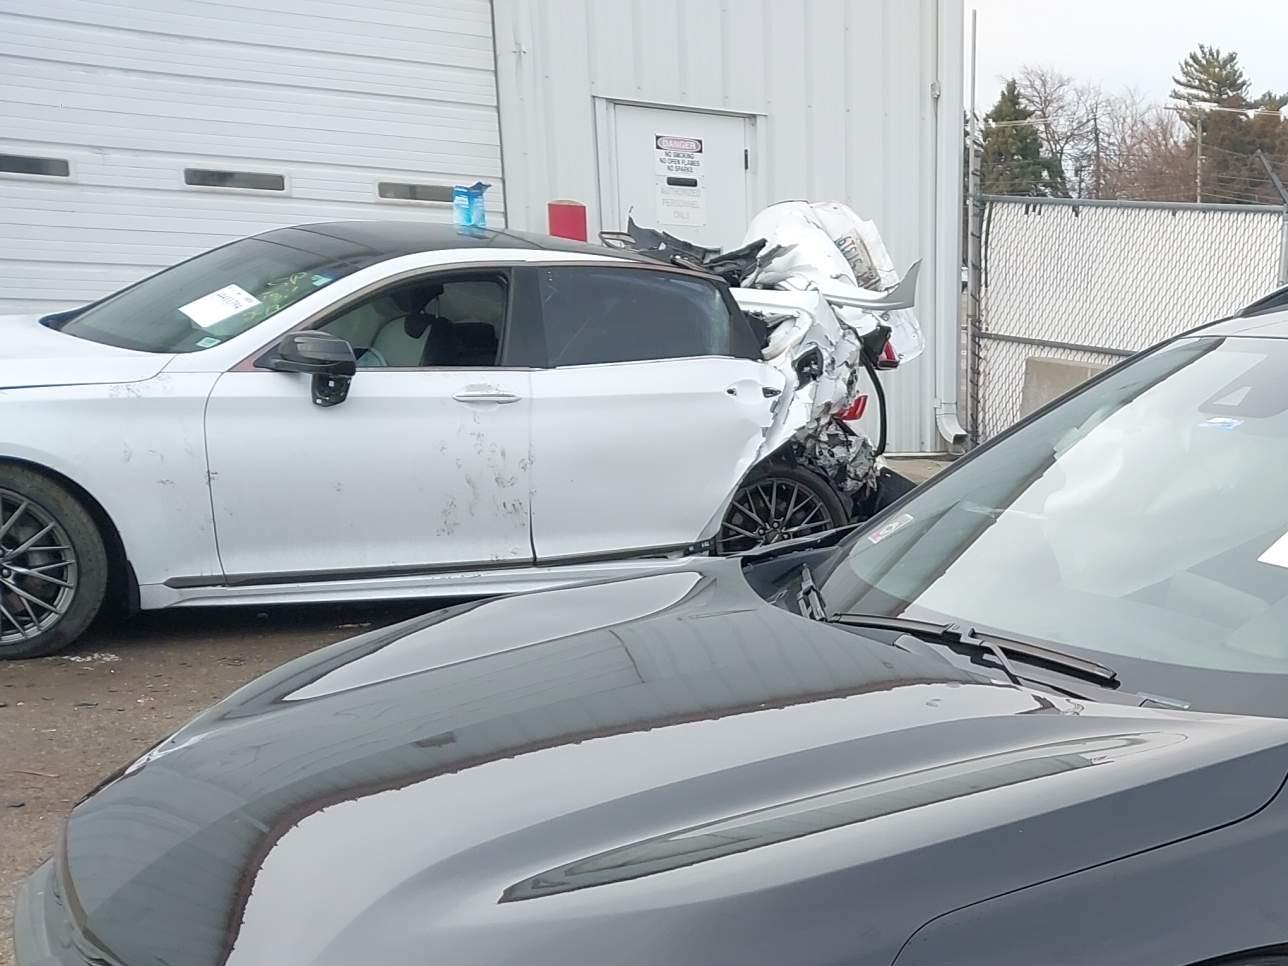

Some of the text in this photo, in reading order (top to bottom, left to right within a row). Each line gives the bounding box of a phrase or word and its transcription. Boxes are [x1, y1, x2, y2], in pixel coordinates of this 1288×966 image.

[662, 139, 697, 150] DANGER
[673, 151, 695, 159] SMOKING
[681, 159, 700, 167] FLAMES
[674, 165, 694, 173] SPARKS
